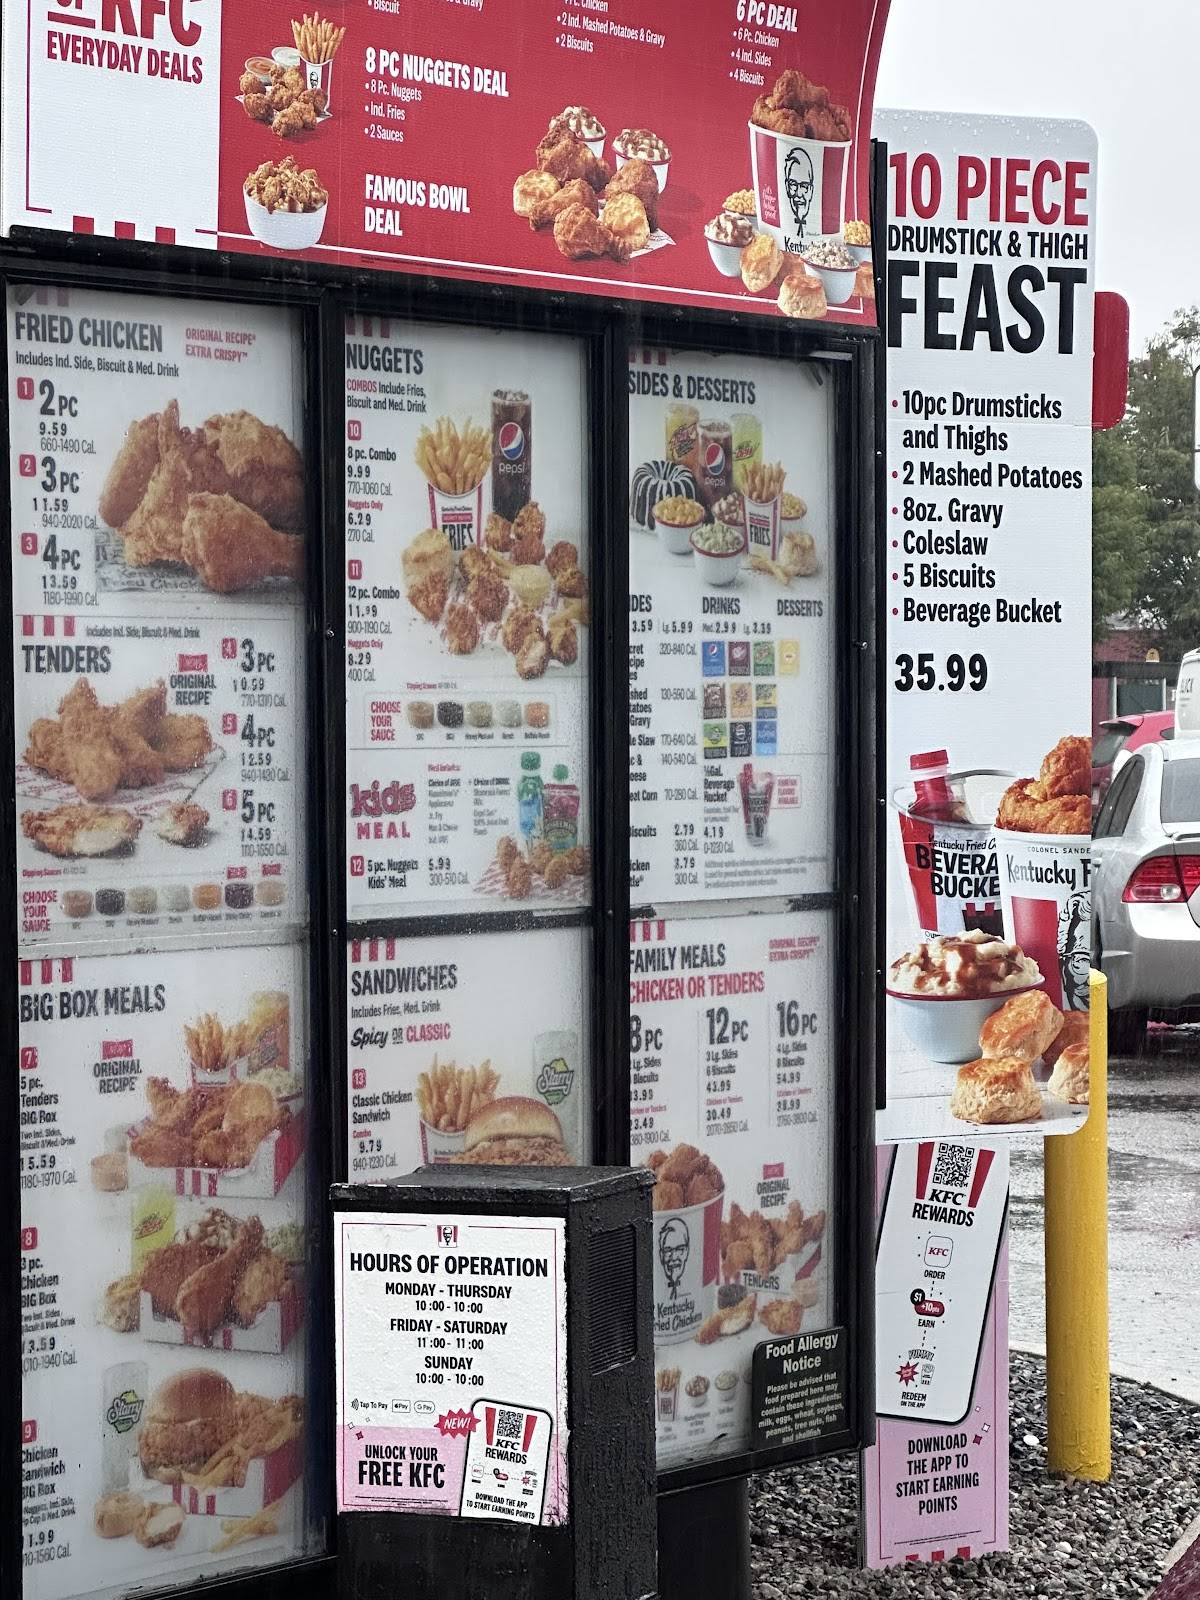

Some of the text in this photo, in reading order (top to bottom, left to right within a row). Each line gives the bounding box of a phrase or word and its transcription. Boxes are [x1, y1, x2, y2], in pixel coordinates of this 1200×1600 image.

[736, 0, 798, 33] 6 PC DEAL
[582, 16, 666, 49] Mashed Potatoes Gravy
[754, 30, 780, 48] Chicken
[566, 35, 594, 53] Biscuits
[47, 30, 203, 84] EVERYDAY DEALS
[754, 51, 772, 67] Sides
[365, 46, 509, 97] 8 PC NUGGETS DEAL
[739, 69, 765, 86] Biscuits
[391, 83, 422, 102] Nuggets
[370, 103, 406, 121] Ind. Fries
[376, 126, 404, 142] Sauces
[365, 173, 471, 214] FAMOUS BOWL
[889, 152, 1090, 226] 10 PIECE
[364, 206, 403, 238] DEAL
[888, 224, 1089, 260] DRUMSTICK & THIGH
[887, 259, 1088, 354] FEAST
[15, 310, 163, 353] FRIED CHICKEN
[185, 326, 224, 343] ORIGINAL
[15, 350, 180, 378] Includes Ind. Side, Biscuit Med. Drink
[346, 342, 425, 376] NUGGETS
[346, 378, 405, 396] COMBOS Include
[629, 370, 757, 405] SIDES & DESSERTS
[346, 395, 427, 413] Biscuit and Med. Drink
[902, 390, 1063, 420] 10pc Drumsticks
[39, 420, 68, 436] 9.59
[902, 423, 1009, 456] and Thighs
[368, 447, 397, 461] Combo
[347, 465, 371, 478] 9.99
[498, 461, 526, 475] pepsi
[902, 460, 1083, 489] 2 Mashed Potatoes
[347, 511, 372, 526] 6.29
[902, 496, 1004, 529] 8oz. Gravy
[902, 529, 989, 556] Coleslaw
[42, 575, 77, 590] 13.59
[902, 562, 996, 588] 5 Biscuits
[372, 585, 400, 600] Combo
[702, 596, 741, 615] DRINKS
[776, 599, 824, 618] DESSERTS
[902, 597, 1063, 628] Beverage Bucket
[21, 644, 112, 674] TENDERS
[893, 652, 989, 693] 35.99
[170, 674, 217, 690] ORIGINAL
[370, 700, 401, 714] CHOOSE
[370, 715, 392, 727] YOUR
[370, 729, 396, 742] SAUCE
[350, 780, 417, 818] kids
[357, 821, 411, 840] MEAL
[387, 858, 419, 874] Nuggets
[1006, 853, 1076, 891] Kentucky
[22, 890, 58, 904] CHOOSE
[22, 905, 48, 919] YOUR
[22, 918, 51, 933] SAUCE
[680, 943, 726, 969] MEALS
[351, 963, 458, 997] SANDWICHES
[629, 970, 765, 1004] CHICKEN OR TENDERS
[20, 983, 167, 1023] BIG BOX MEALS
[351, 1002, 382, 1019] Includes
[351, 1022, 451, 1050] Spicy CLASSIC
[93, 1058, 143, 1078] ORIGINAL
[20, 1092, 59, 1108] Tenders
[352, 1090, 413, 1108] Classic Chicken
[20, 1109, 57, 1126] BIG Box
[352, 1109, 391, 1125] Sandwich
[756, 1179, 791, 1195] ORIGINAL
[928, 1188, 966, 1206] KFC
[911, 1202, 975, 1227] REWARDS
[927, 1246, 949, 1257] KFC
[350, 1252, 549, 1278] HOURS OF OPERATION
[21, 1272, 60, 1291] Chicken
[923, 1269, 946, 1280] ORDER
[38, 1291, 57, 1306] Box
[385, 1282, 513, 1299] MONDAY THURSDAY
[656, 1299, 695, 1317] Kentucky
[390, 1318, 508, 1335] FRIDAY SATURDAY
[917, 1318, 936, 1329] EARN
[765, 1333, 839, 1359] Food Allergy
[424, 1355, 474, 1370] SUNDAY
[783, 1355, 822, 1375] Notice
[767, 1384, 788, 1394] Please
[901, 1391, 927, 1402] REDEEM
[443, 1416, 471, 1430] NEW!
[364, 1444, 438, 1462] UNLOCK YOUR
[495, 1438, 521, 1451] KFC
[907, 1433, 968, 1455] DOWNLOAD
[485, 1448, 528, 1465] REWARDS
[907, 1453, 969, 1476] THE APP TO
[358, 1460, 406, 1488] FREE
[409, 1462, 446, 1489] KFC
[896, 1472, 980, 1498] START EARNING
[475, 1492, 505, 1506] DOWNLOAD
[918, 1496, 958, 1516] POINTS
[473, 1500, 535, 1520] START EARNING POINTS
